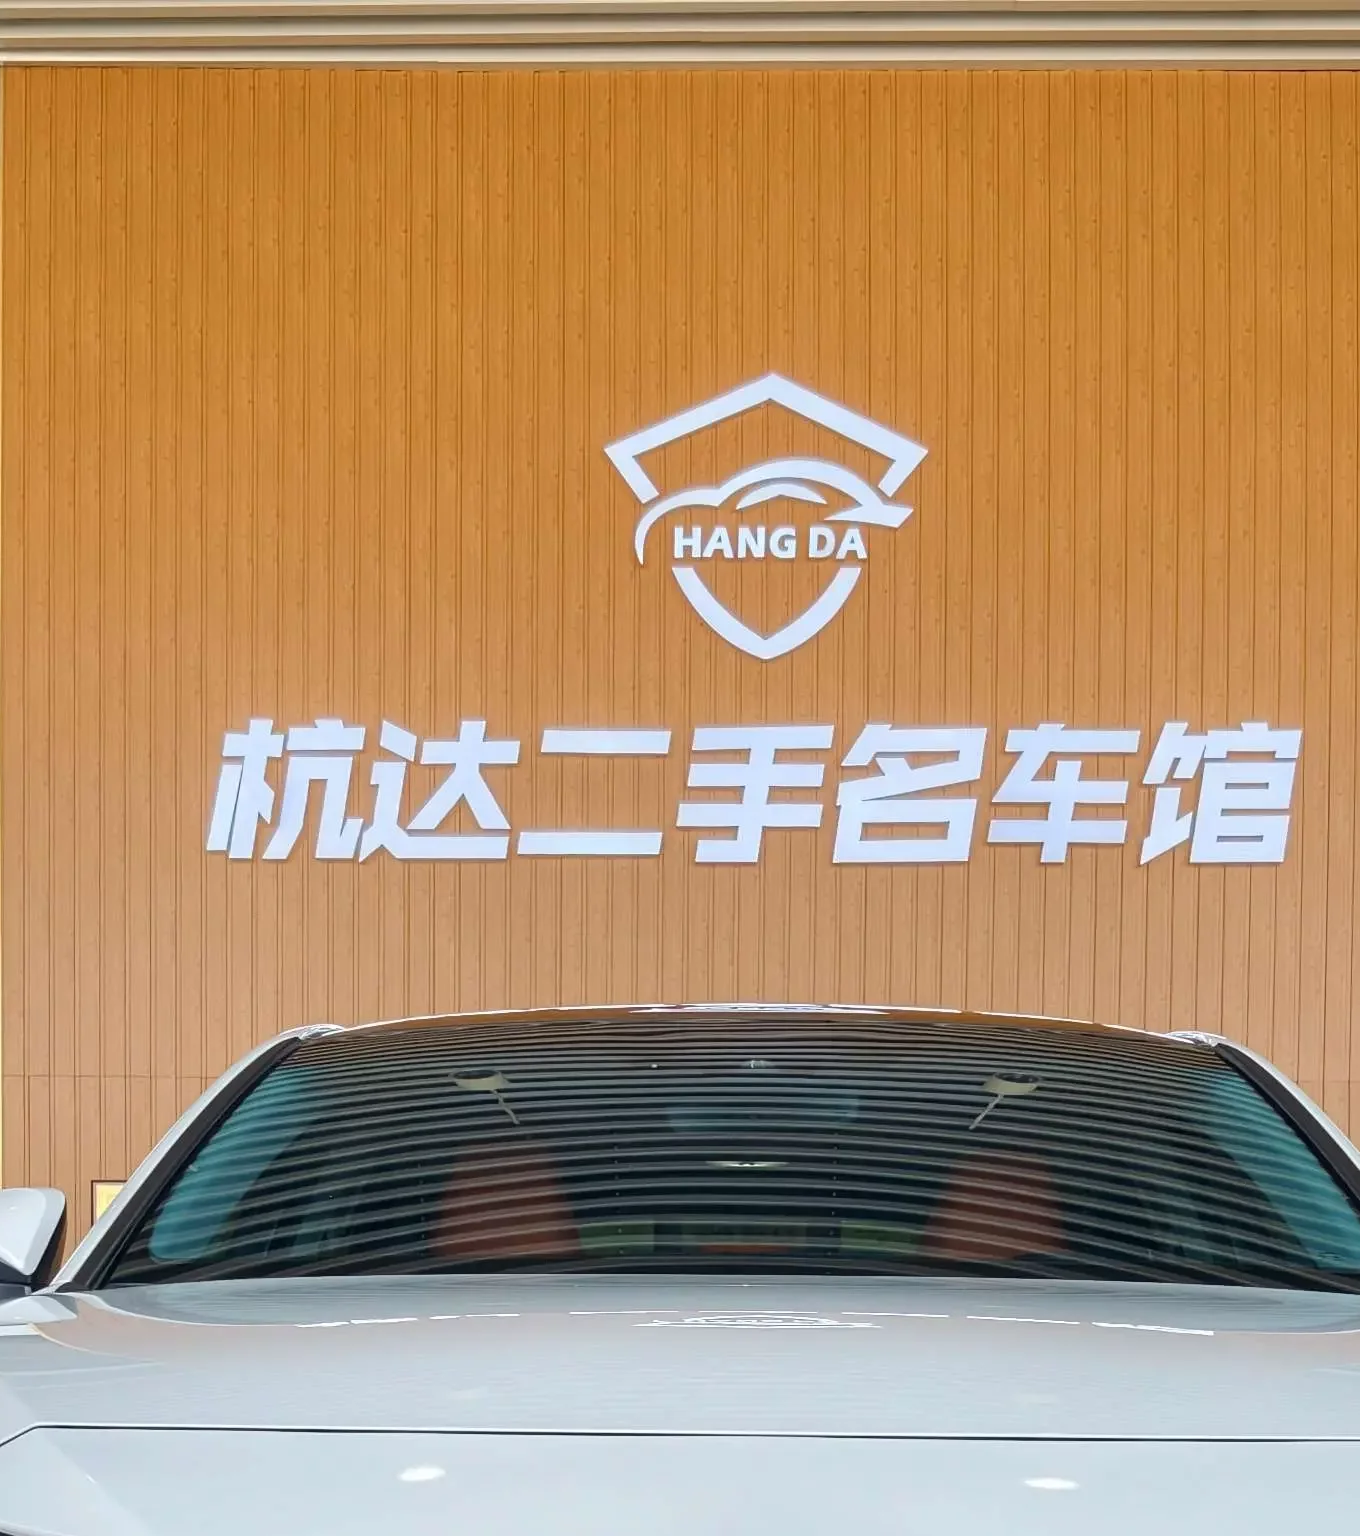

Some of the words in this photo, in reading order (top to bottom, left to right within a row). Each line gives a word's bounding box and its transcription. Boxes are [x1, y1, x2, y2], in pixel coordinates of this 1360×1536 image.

[673, 525, 797, 559] HANG
[808, 526, 868, 560] DA
[207, 718, 1303, 866] 杭达二手名车馆
